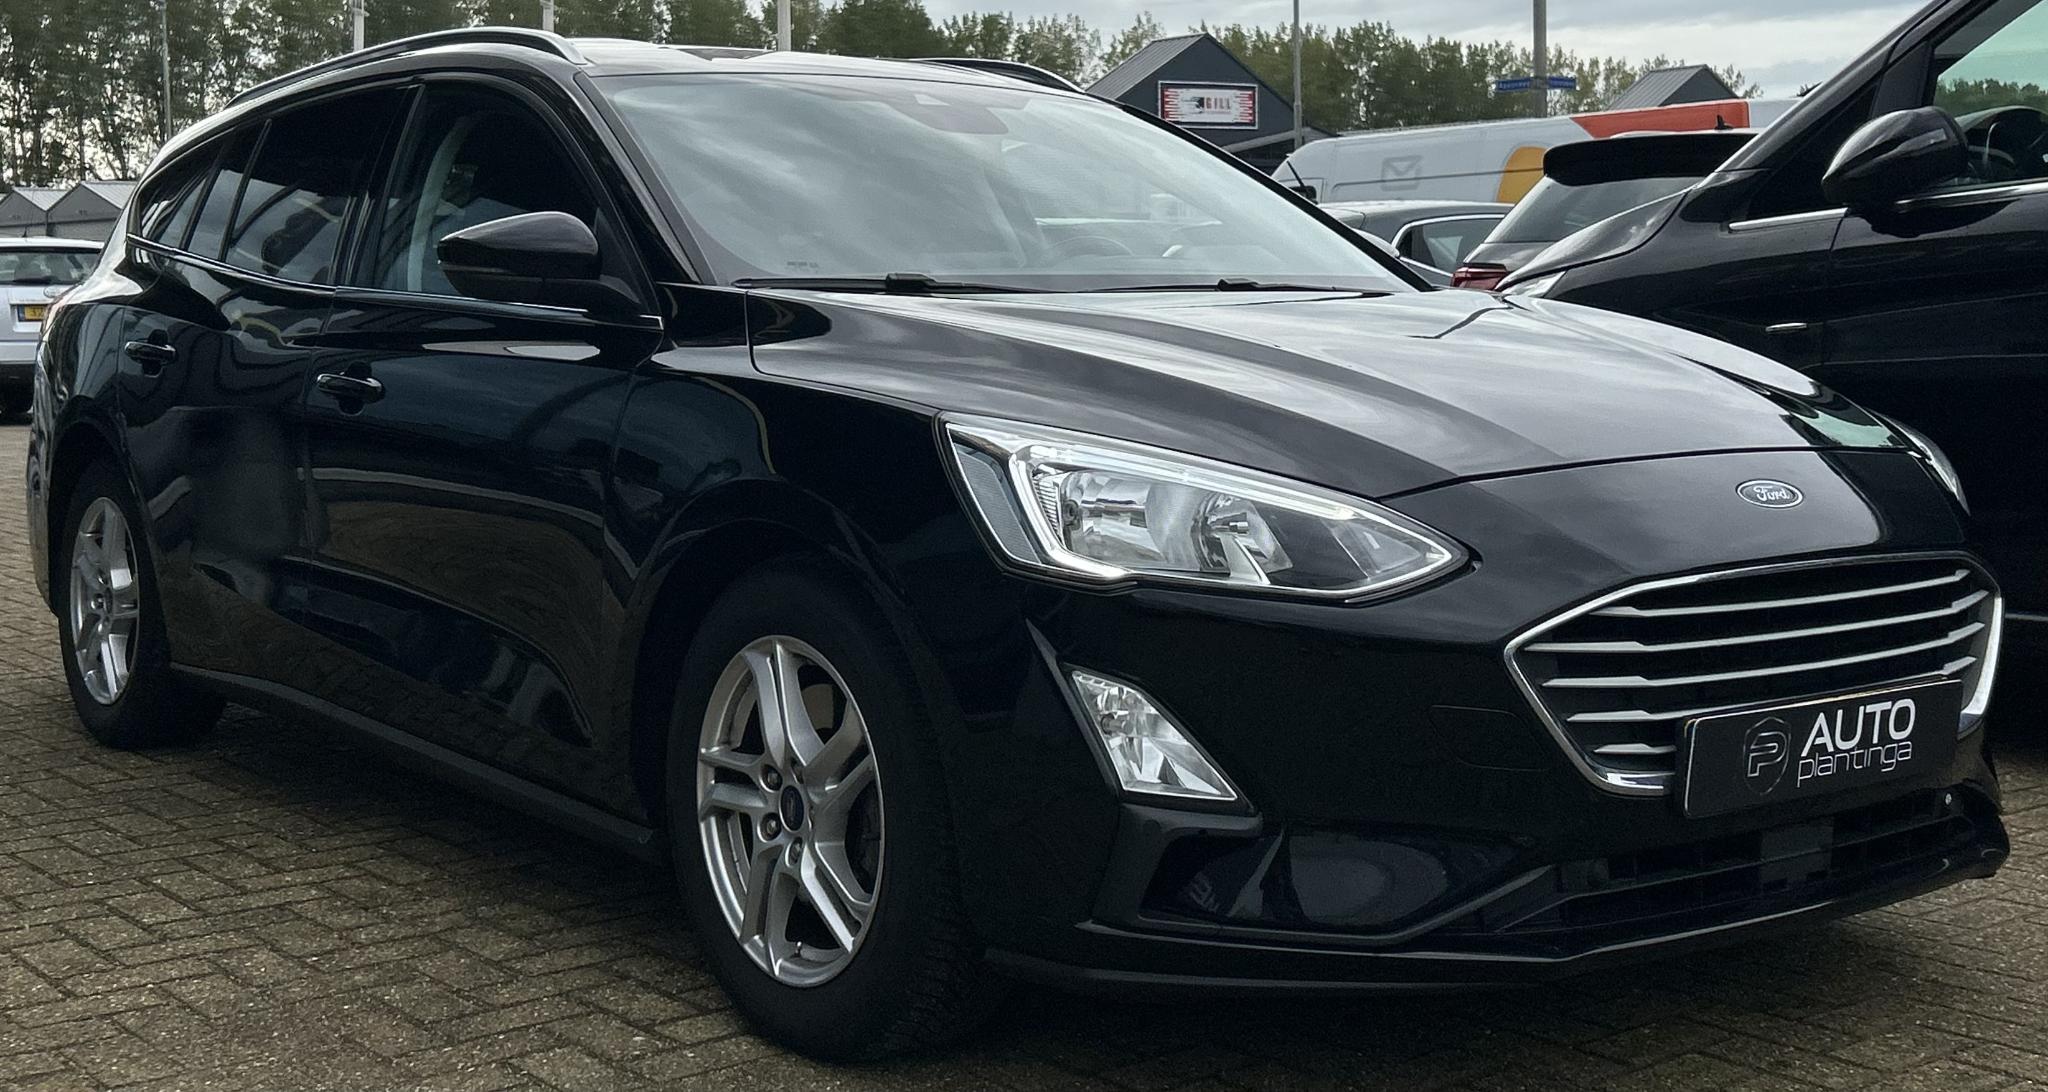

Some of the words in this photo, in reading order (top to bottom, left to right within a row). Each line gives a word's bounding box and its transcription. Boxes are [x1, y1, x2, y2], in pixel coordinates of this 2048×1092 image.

[1753, 485, 1790, 501] Ford
[1800, 698, 1916, 757] AUTO
[1796, 741, 1913, 788] plantinga
